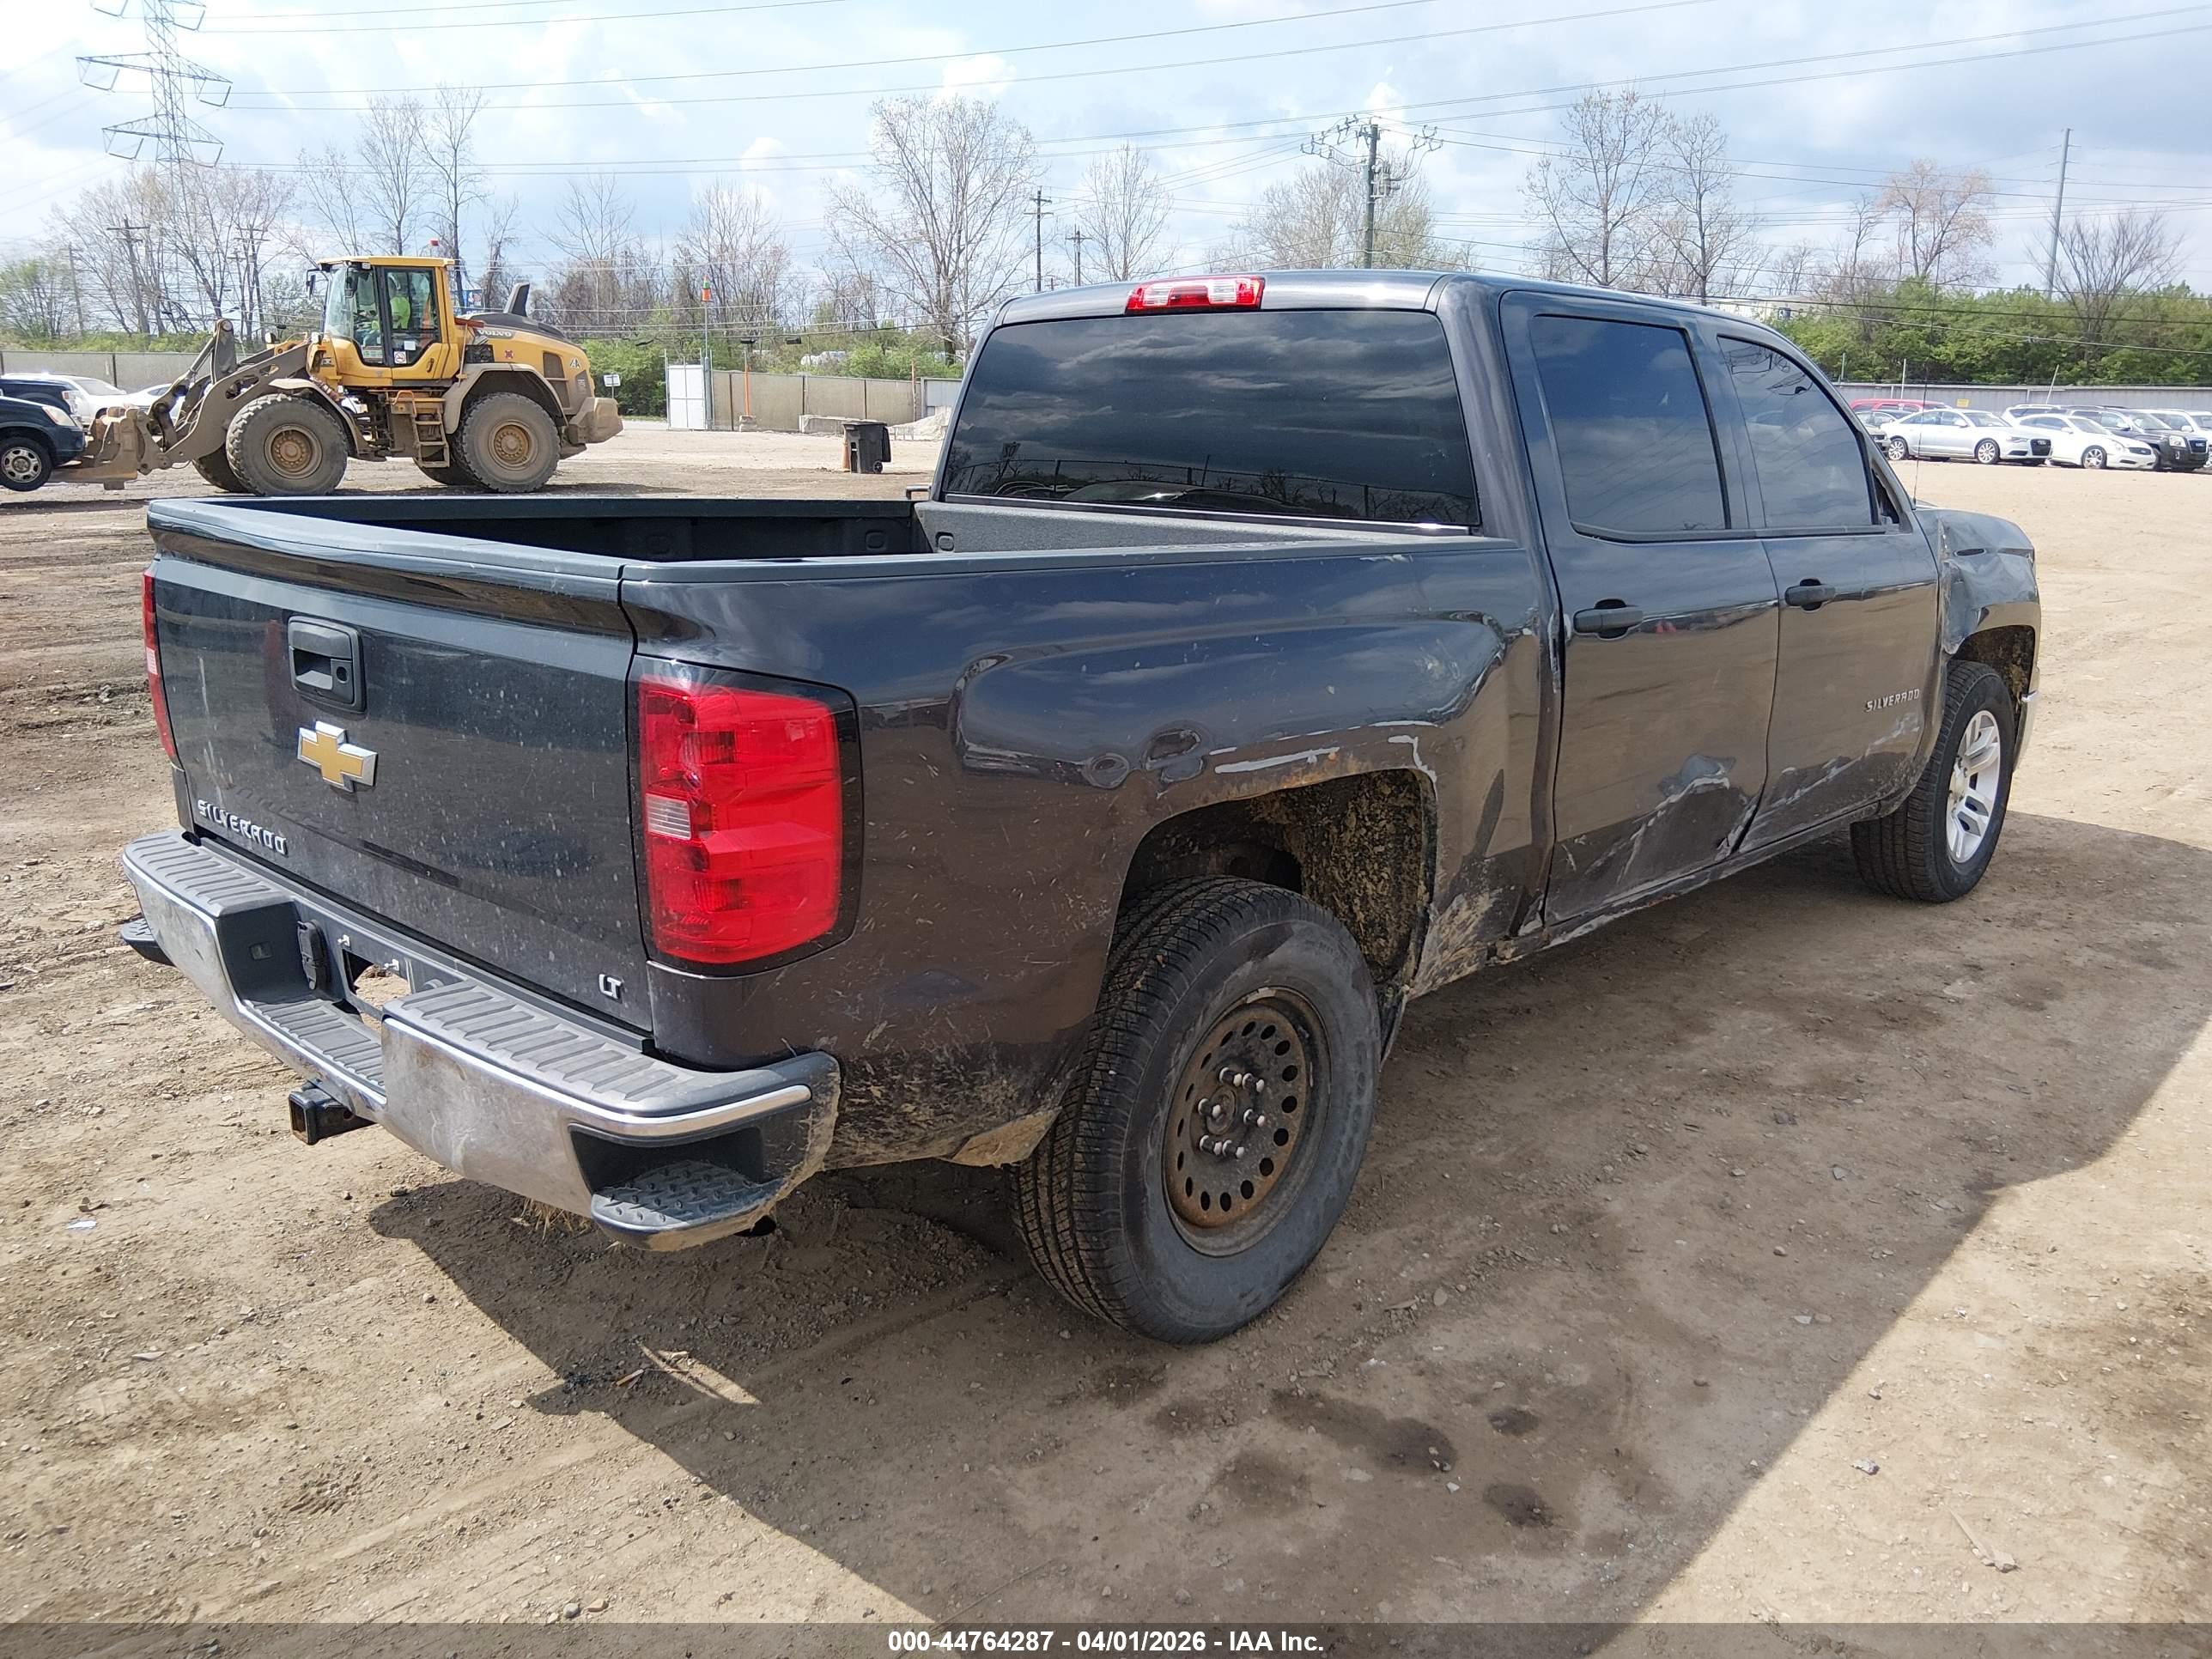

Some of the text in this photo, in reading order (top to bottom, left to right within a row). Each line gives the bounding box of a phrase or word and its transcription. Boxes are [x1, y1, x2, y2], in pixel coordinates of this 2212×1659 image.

[477, 329, 512, 337] VOLVO
[1864, 688, 1920, 713] SILVERADO
[198, 799, 287, 855] SILVERADO
[599, 973, 622, 1000] LT
